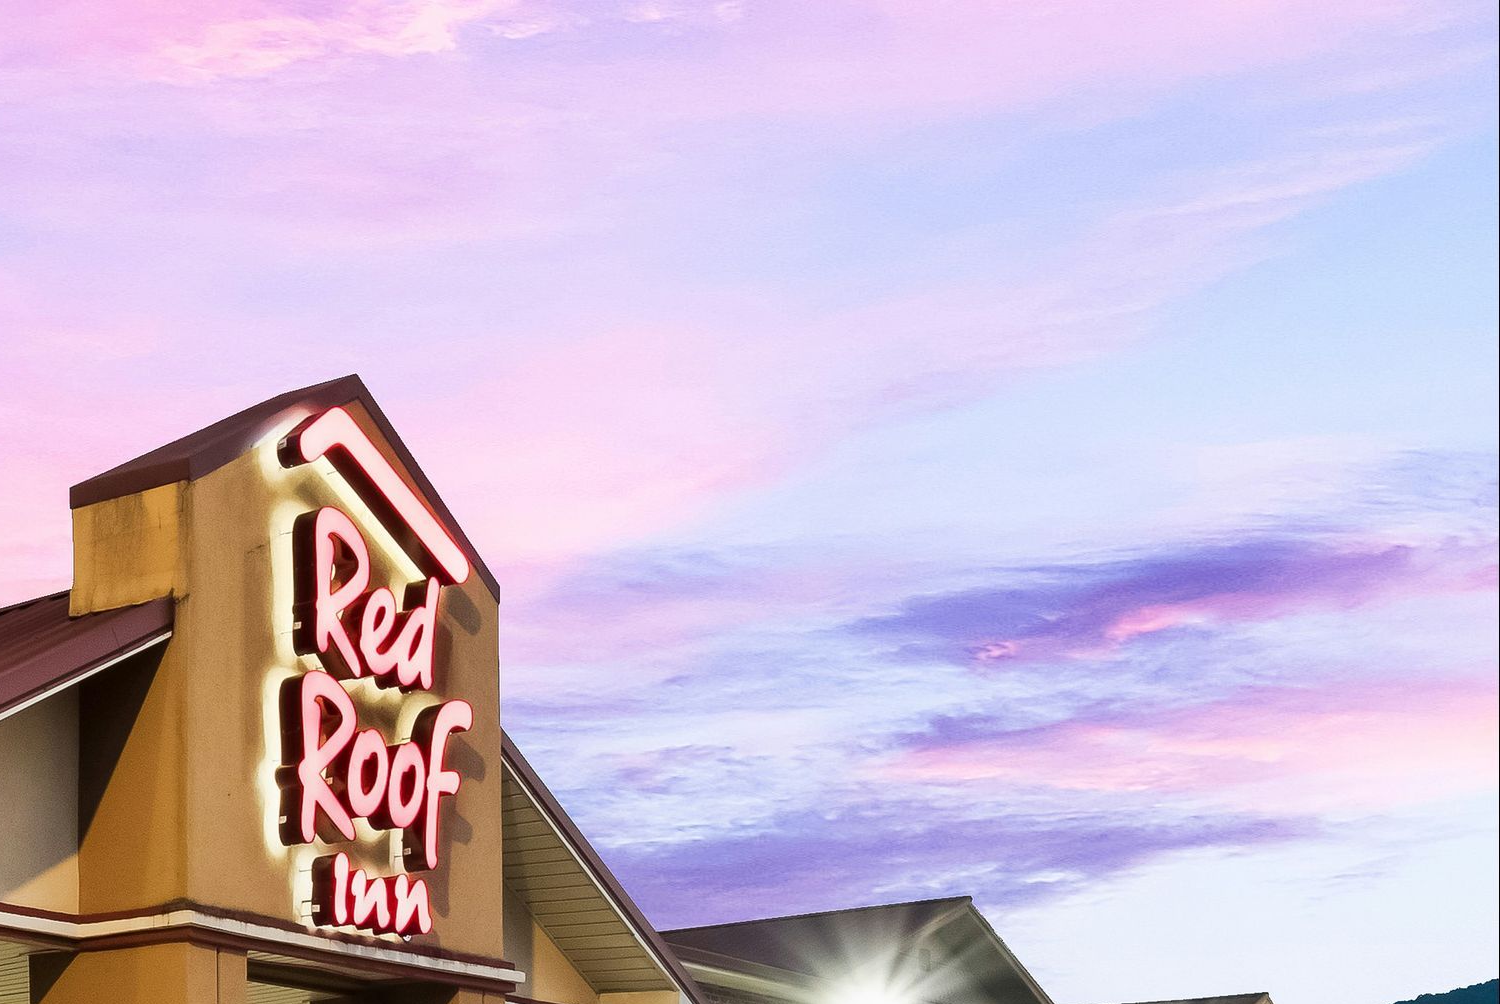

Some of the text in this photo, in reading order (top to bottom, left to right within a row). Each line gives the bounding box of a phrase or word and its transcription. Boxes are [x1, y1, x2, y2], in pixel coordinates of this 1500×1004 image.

[315, 505, 440, 691] Red
[298, 670, 473, 870] Roof
[331, 852, 433, 935] Inn
